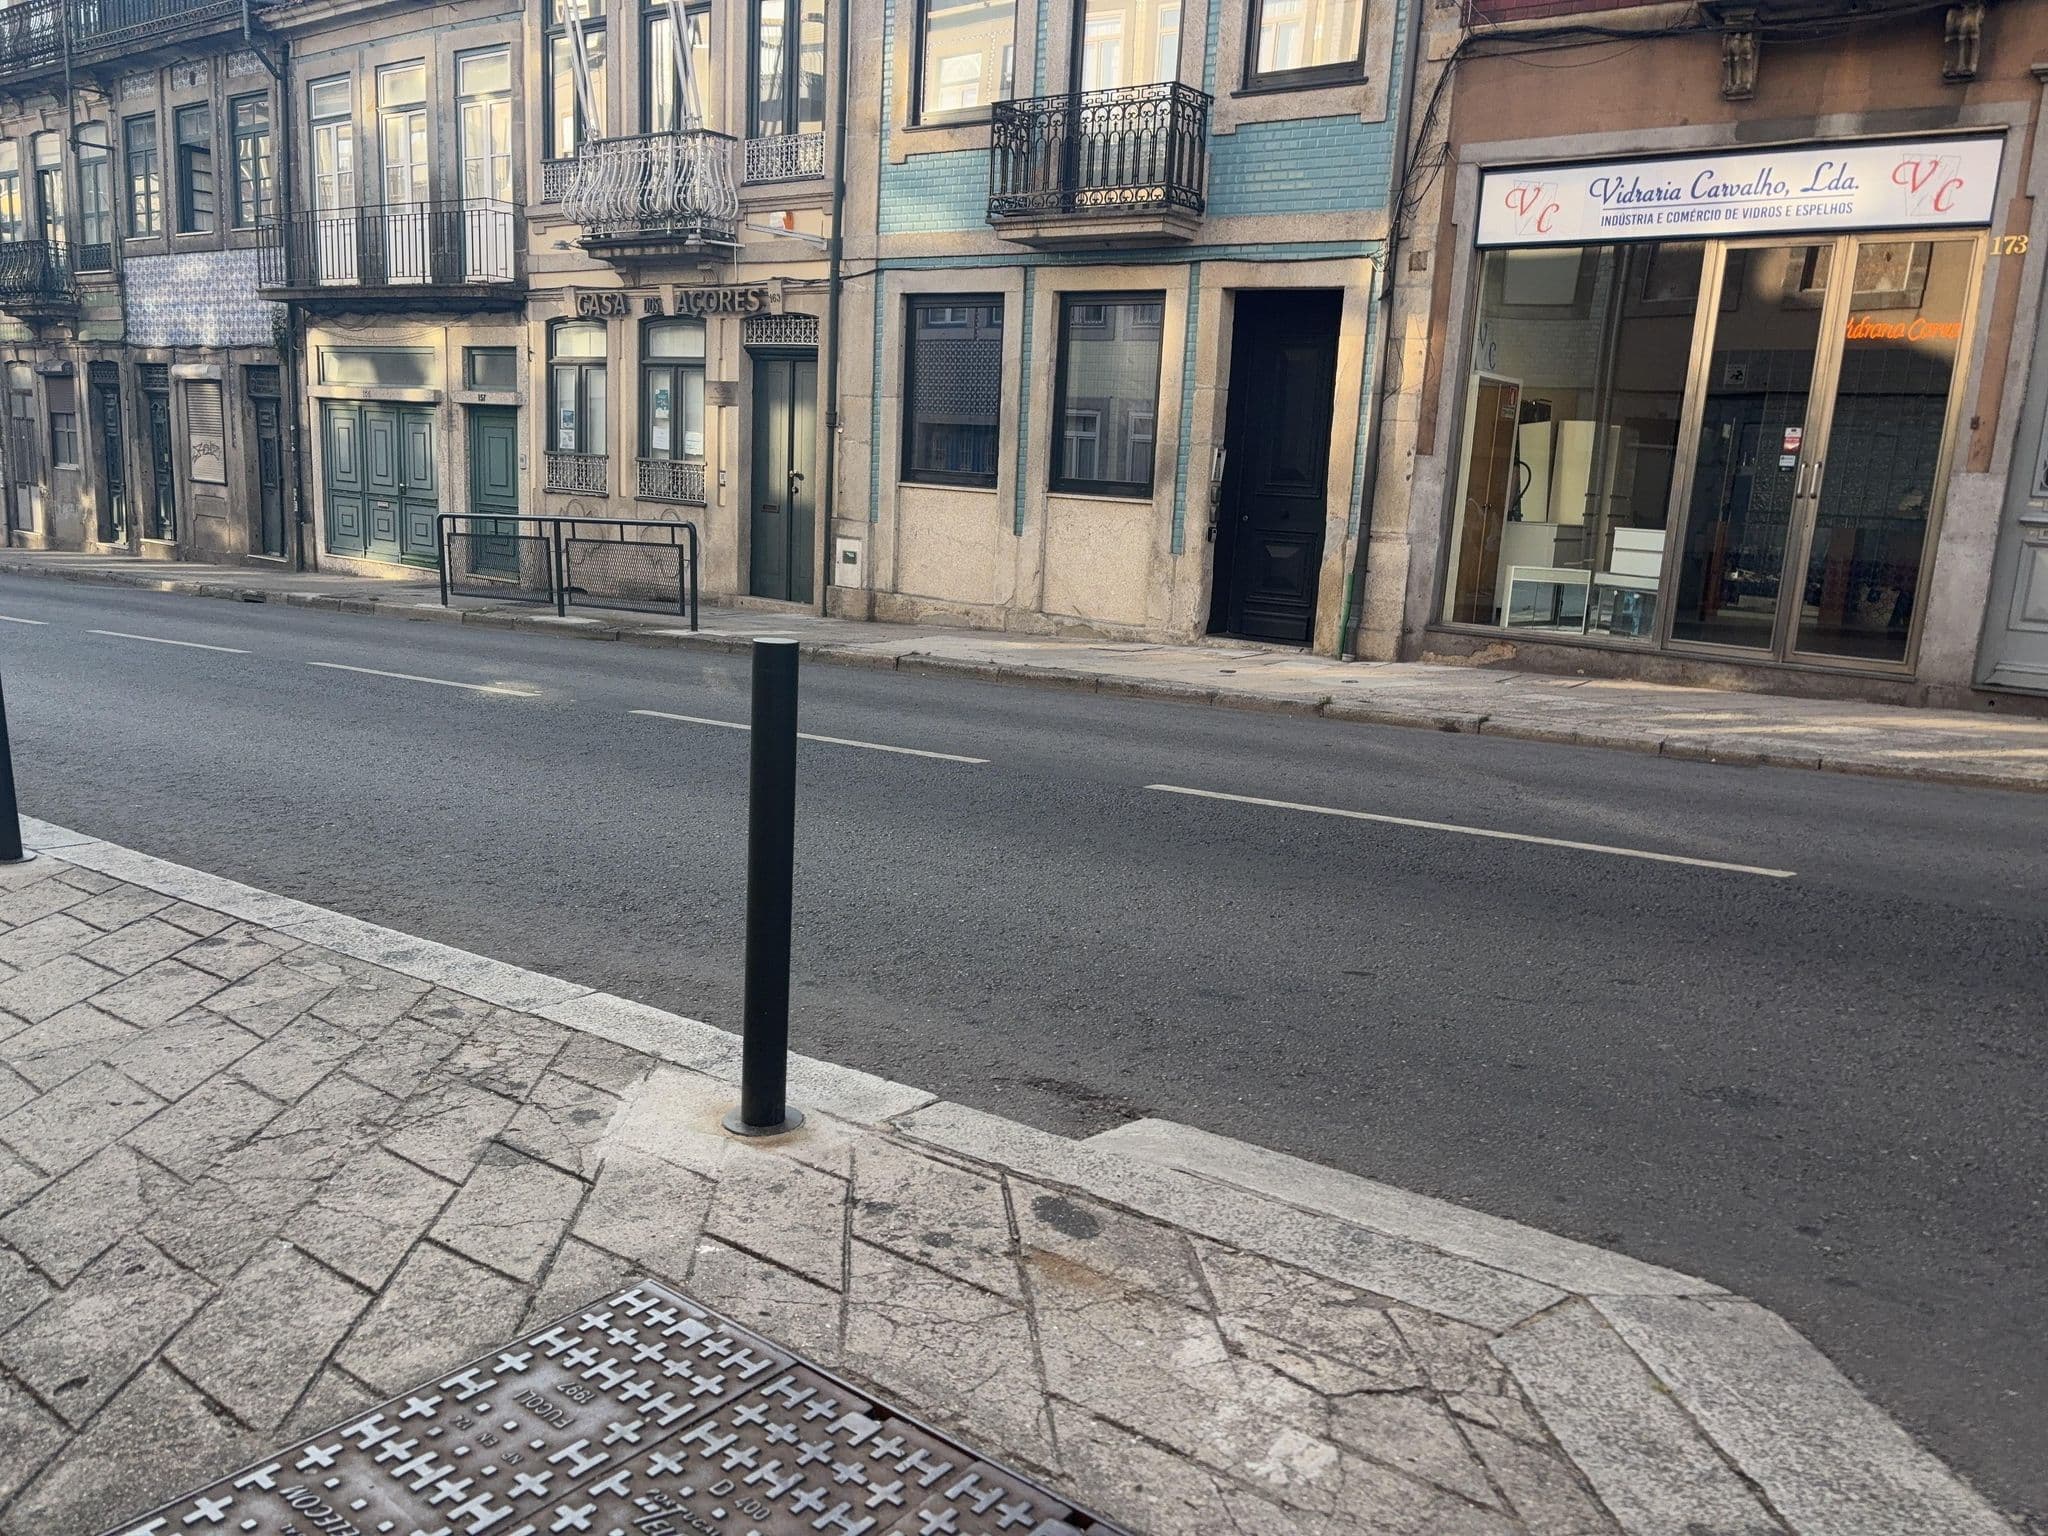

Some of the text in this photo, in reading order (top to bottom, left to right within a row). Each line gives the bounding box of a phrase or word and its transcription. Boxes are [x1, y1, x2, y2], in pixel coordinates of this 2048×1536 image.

[1589, 161, 1860, 205] Vidraria Carvalho, Lda.
[1600, 202, 1854, 227] INDÚSTRIA E COMÉRCIO DE VIDROS E ESPELHOS
[1990, 234, 2029, 255] 173
[576, 292, 627, 316] CASA
[676, 289, 761, 318] AÇORES
[513, 1388, 576, 1430] FUCOLI
[556, 1381, 598, 1405] 1997
[279, 1484, 361, 1536] ELECOM
[708, 1478, 771, 1521] D 400
